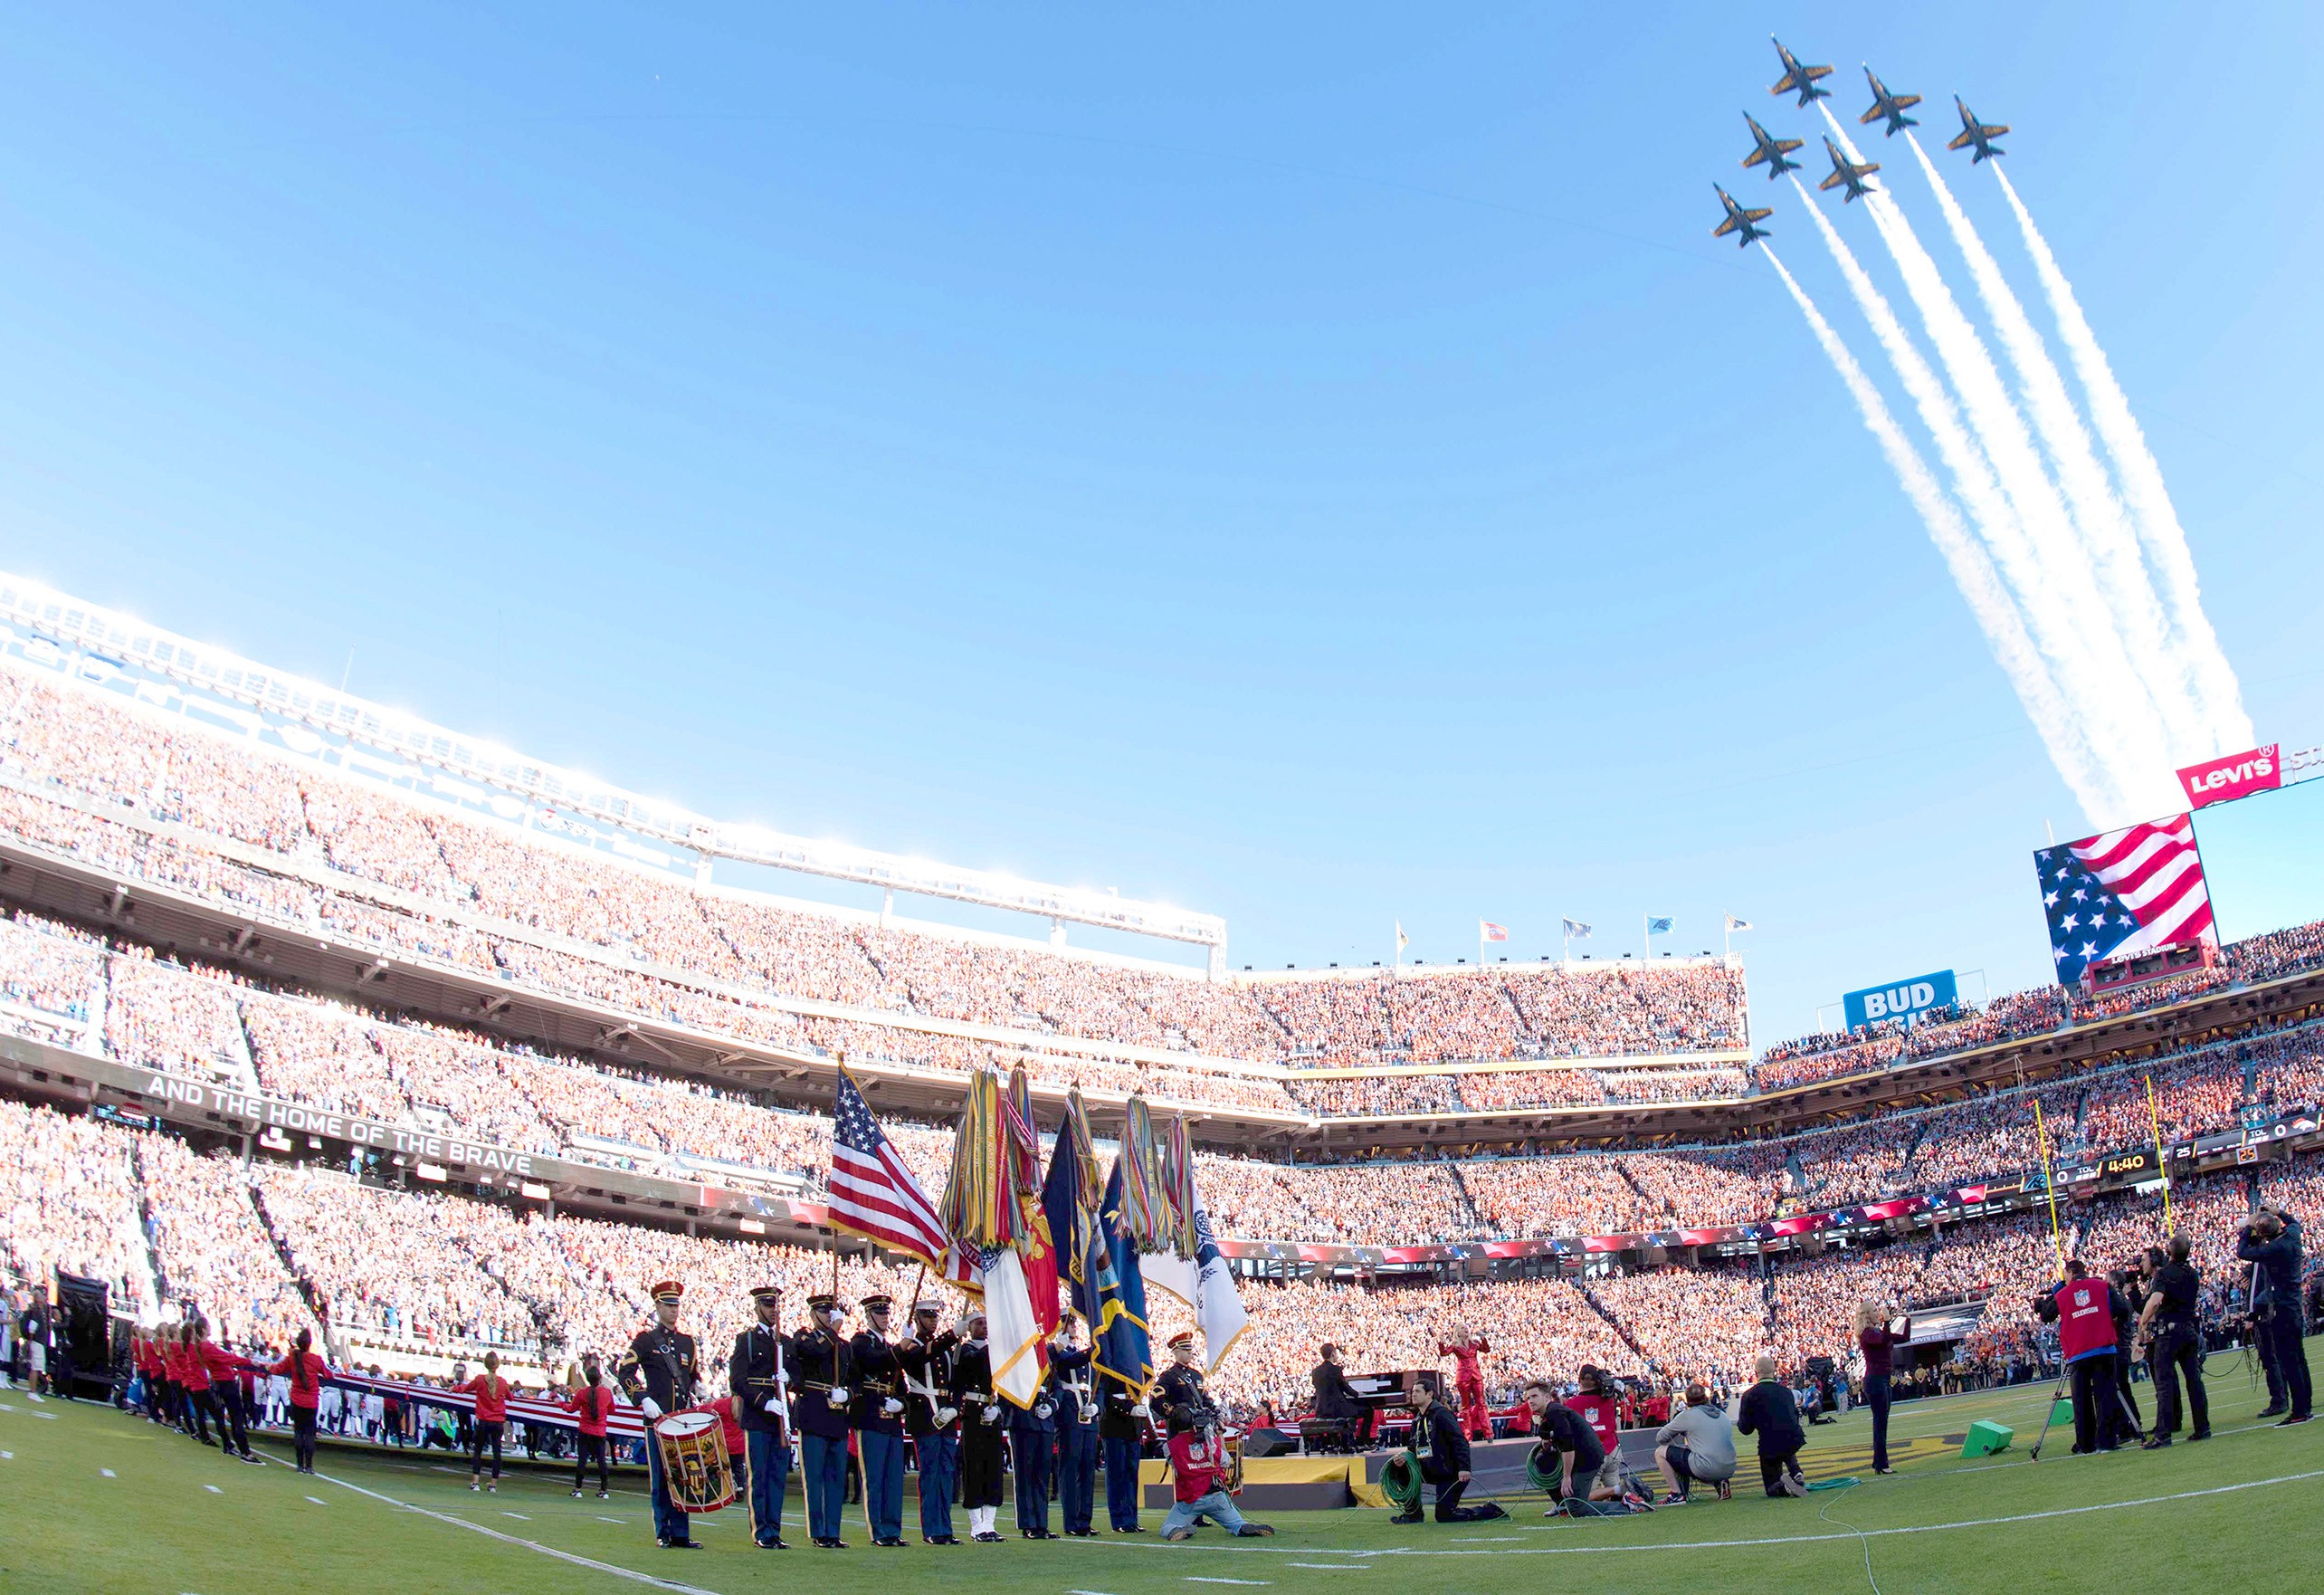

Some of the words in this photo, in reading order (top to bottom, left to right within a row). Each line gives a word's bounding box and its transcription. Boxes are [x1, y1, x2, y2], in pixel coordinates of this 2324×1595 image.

[2142, 942, 2176, 957] STADIUM
[1864, 982, 1935, 1019] BUD
[148, 1075, 203, 1105] AND
[212, 1089, 262, 1119] THE
[270, 1104, 343, 1137] HOME
[350, 1122, 385, 1143] OF
[392, 1131, 441, 1157] THE
[449, 1142, 531, 1174] BRAVE
[2250, 1129, 2267, 1138] TOL
[2274, 1124, 2287, 1137] 0
[2176, 1147, 2191, 1159] 25
[2239, 1148, 2255, 1161] 25
[2108, 1155, 2145, 1173] 4:40
[2056, 1170, 2068, 1183] 0
[2078, 1165, 2095, 1174] TOL
[959, 1237, 982, 1265] UNIT
[1071, 1259, 1082, 1278] TED
[2072, 1305, 2099, 1319] TELEVISION
